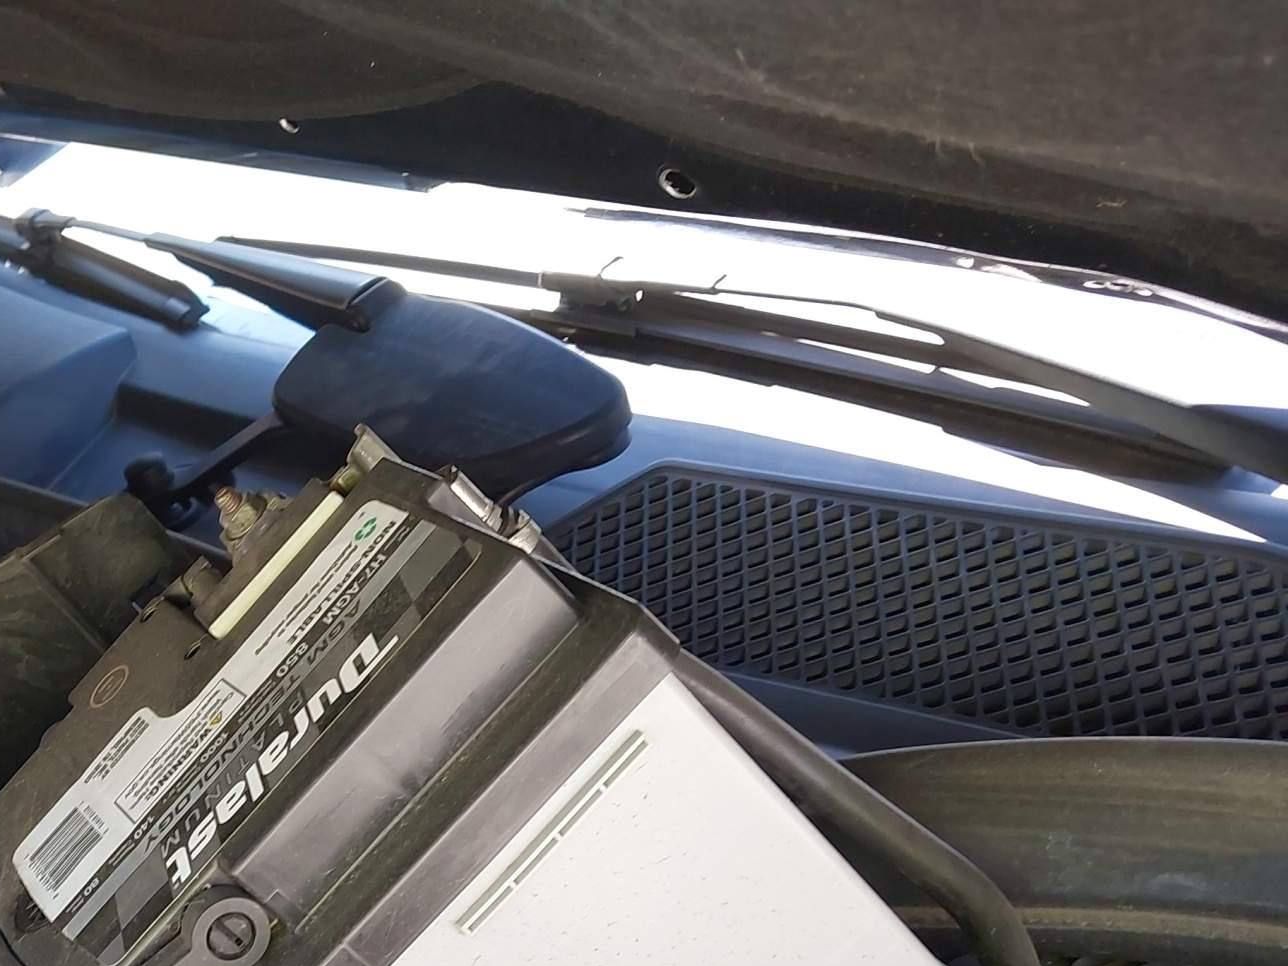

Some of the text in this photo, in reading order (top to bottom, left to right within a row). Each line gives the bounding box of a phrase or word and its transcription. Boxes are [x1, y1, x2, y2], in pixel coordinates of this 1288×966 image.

[286, 520, 397, 645] NON-SPILLABLE
[320, 553, 386, 624] H7-AGM
[273, 641, 309, 678] 850
[308, 598, 359, 664] AGM
[144, 675, 300, 854] TECHNOLOGY
[144, 728, 211, 802] WARNING:
[160, 691, 301, 858] PLATINUM
[162, 632, 400, 884] Duralast
[198, 731, 228, 763] 1000
[132, 815, 154, 840] 140
[82, 877, 100, 896] 80
